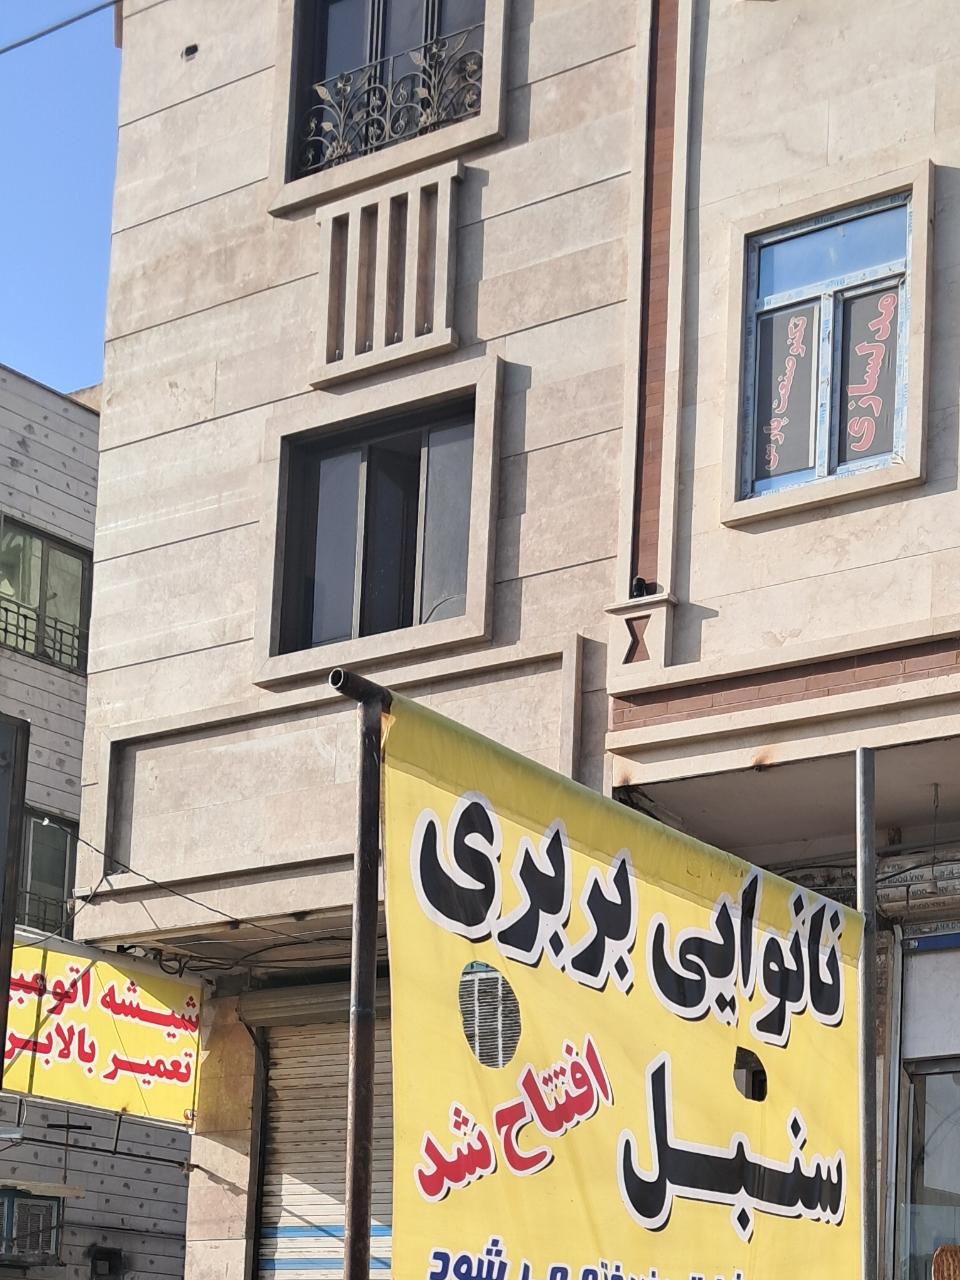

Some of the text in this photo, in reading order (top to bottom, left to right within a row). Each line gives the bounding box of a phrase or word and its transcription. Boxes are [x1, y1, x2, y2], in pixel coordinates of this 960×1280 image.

[416, 800, 846, 1042] نانوایی بربری
[4, 1022, 193, 1086] تعمیر بالابر
[100, 980, 200, 1032] شیشه
[416, 1035, 614, 1201] افتتاح شد
[621, 1058, 847, 1240] سنبل
